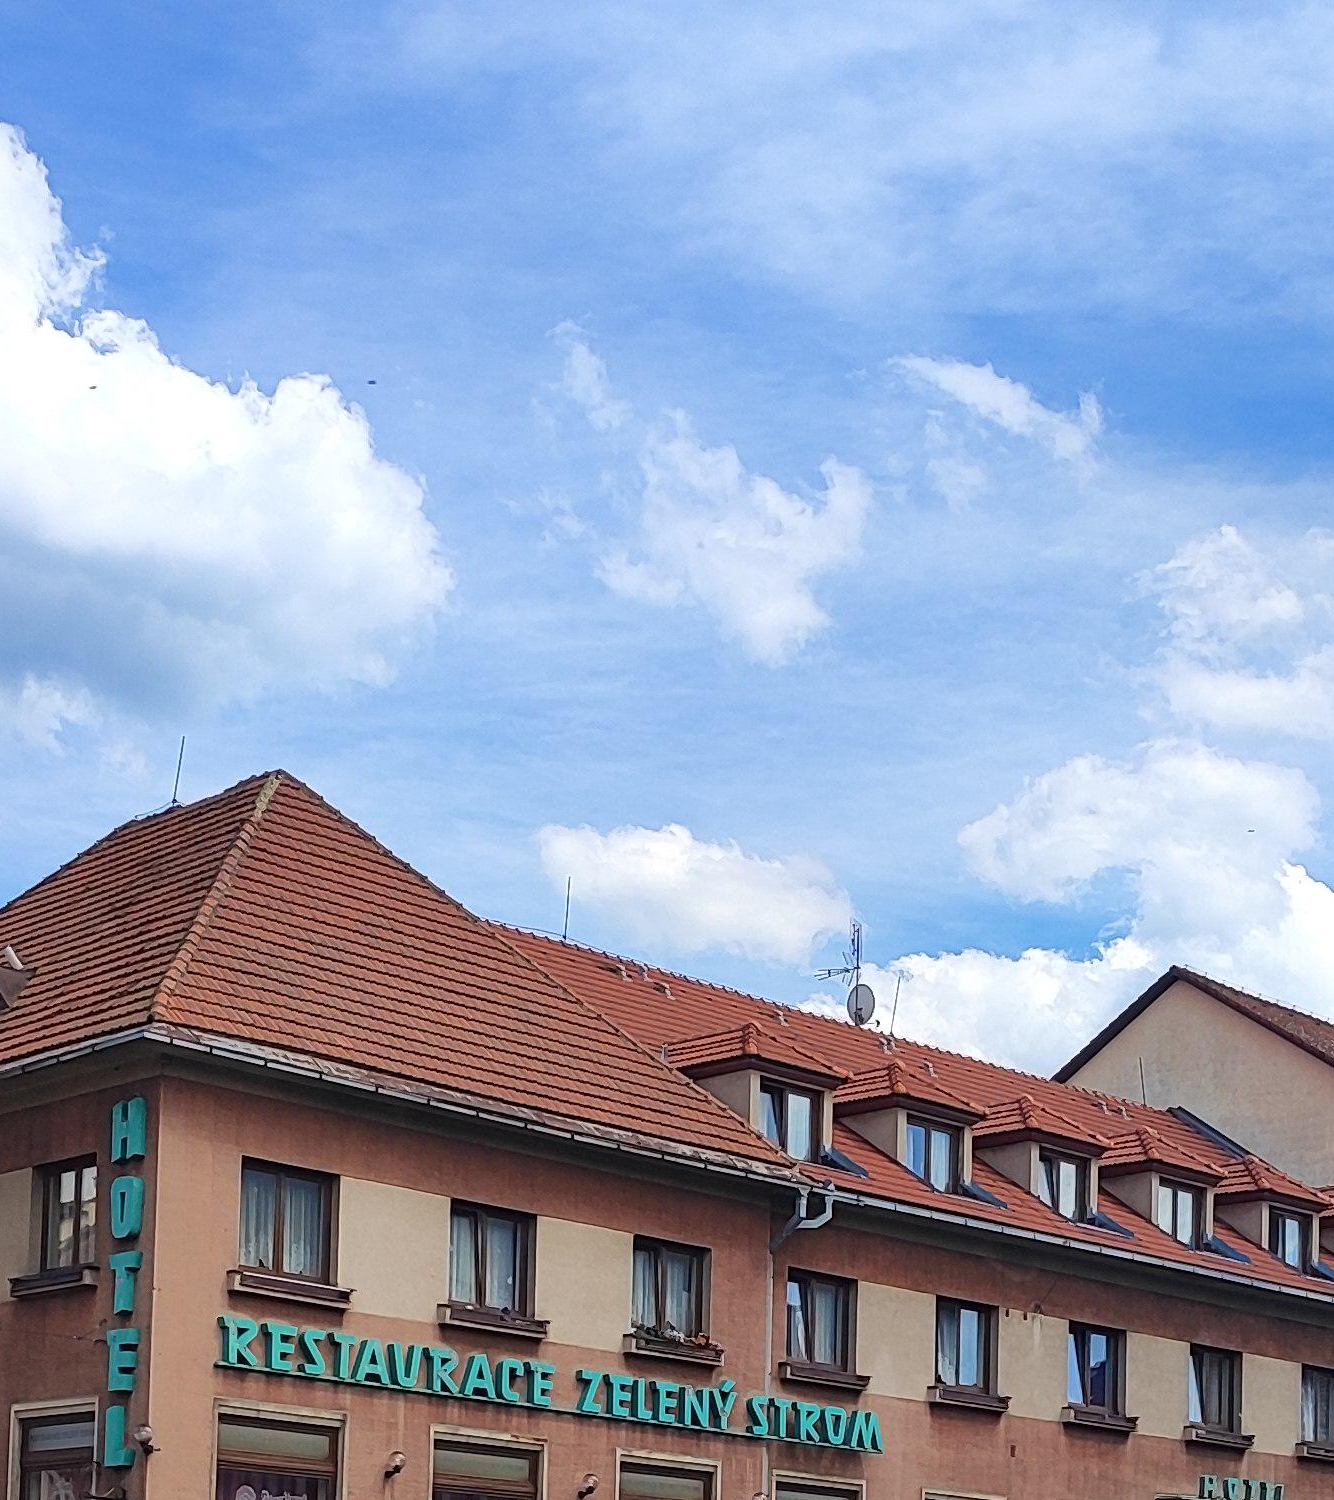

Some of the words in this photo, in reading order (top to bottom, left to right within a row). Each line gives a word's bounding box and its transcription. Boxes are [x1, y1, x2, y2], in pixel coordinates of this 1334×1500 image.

[103, 1096, 147, 1467] HOTEL
[217, 1316, 556, 1407] RESTAURACE
[576, 1369, 738, 1430] ZELENÝ
[746, 1395, 883, 1450] STROM
